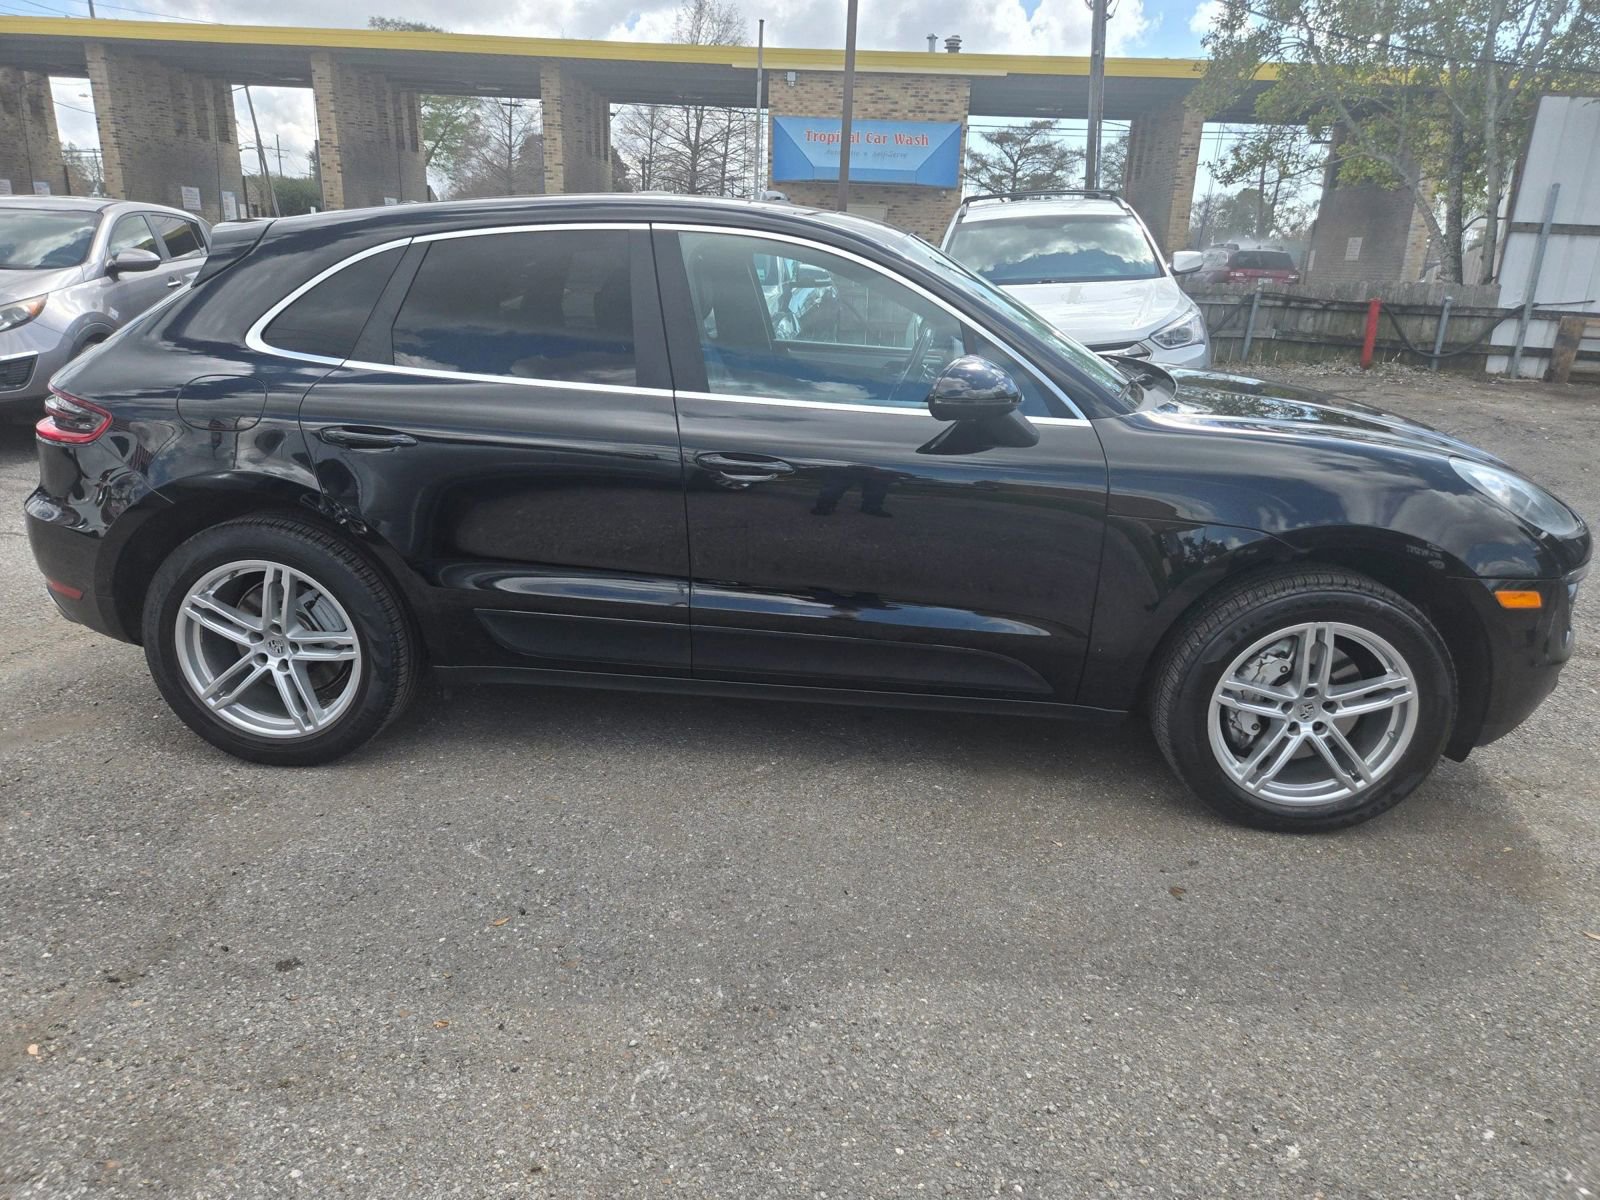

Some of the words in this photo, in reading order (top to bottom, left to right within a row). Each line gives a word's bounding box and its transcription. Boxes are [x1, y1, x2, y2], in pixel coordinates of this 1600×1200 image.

[805, 130, 860, 145] Tropial
[865, 132, 888, 145] Car
[894, 133, 929, 146] Wash
